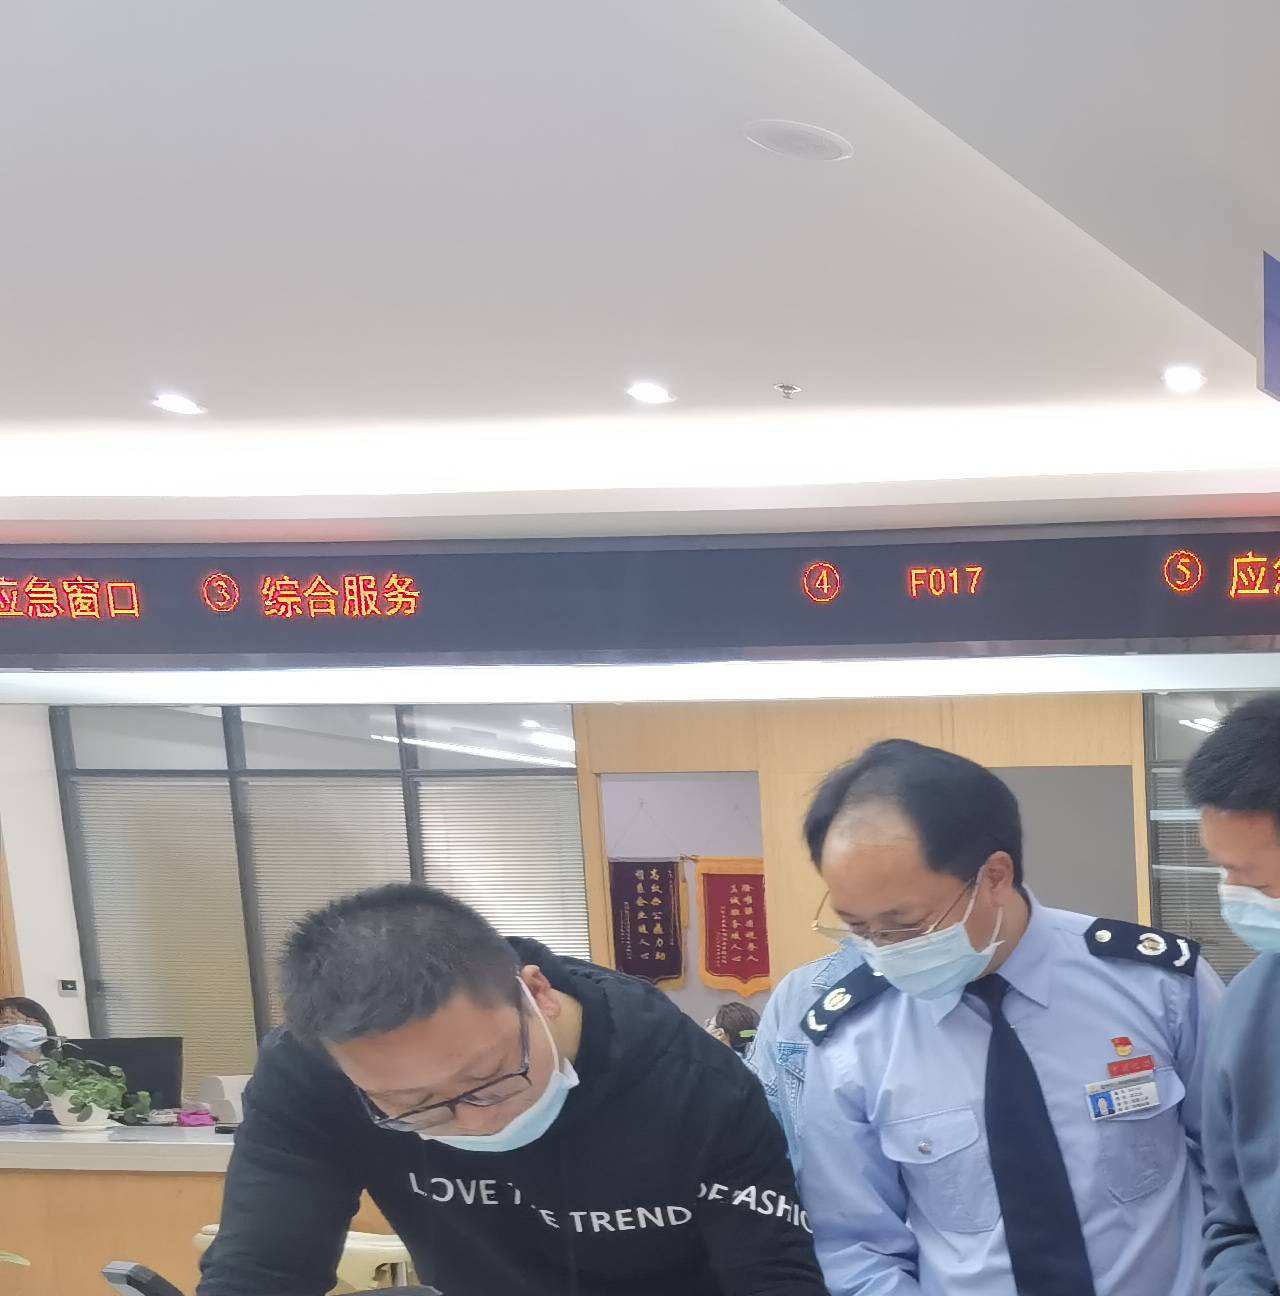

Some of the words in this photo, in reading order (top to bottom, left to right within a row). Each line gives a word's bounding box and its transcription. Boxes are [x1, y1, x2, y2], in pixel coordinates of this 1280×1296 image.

[260, 574, 420, 618] 综合服务
[908, 565, 983, 597] F017
[409, 1172, 499, 1205] LOVE
[568, 1205, 693, 1233] TREND
